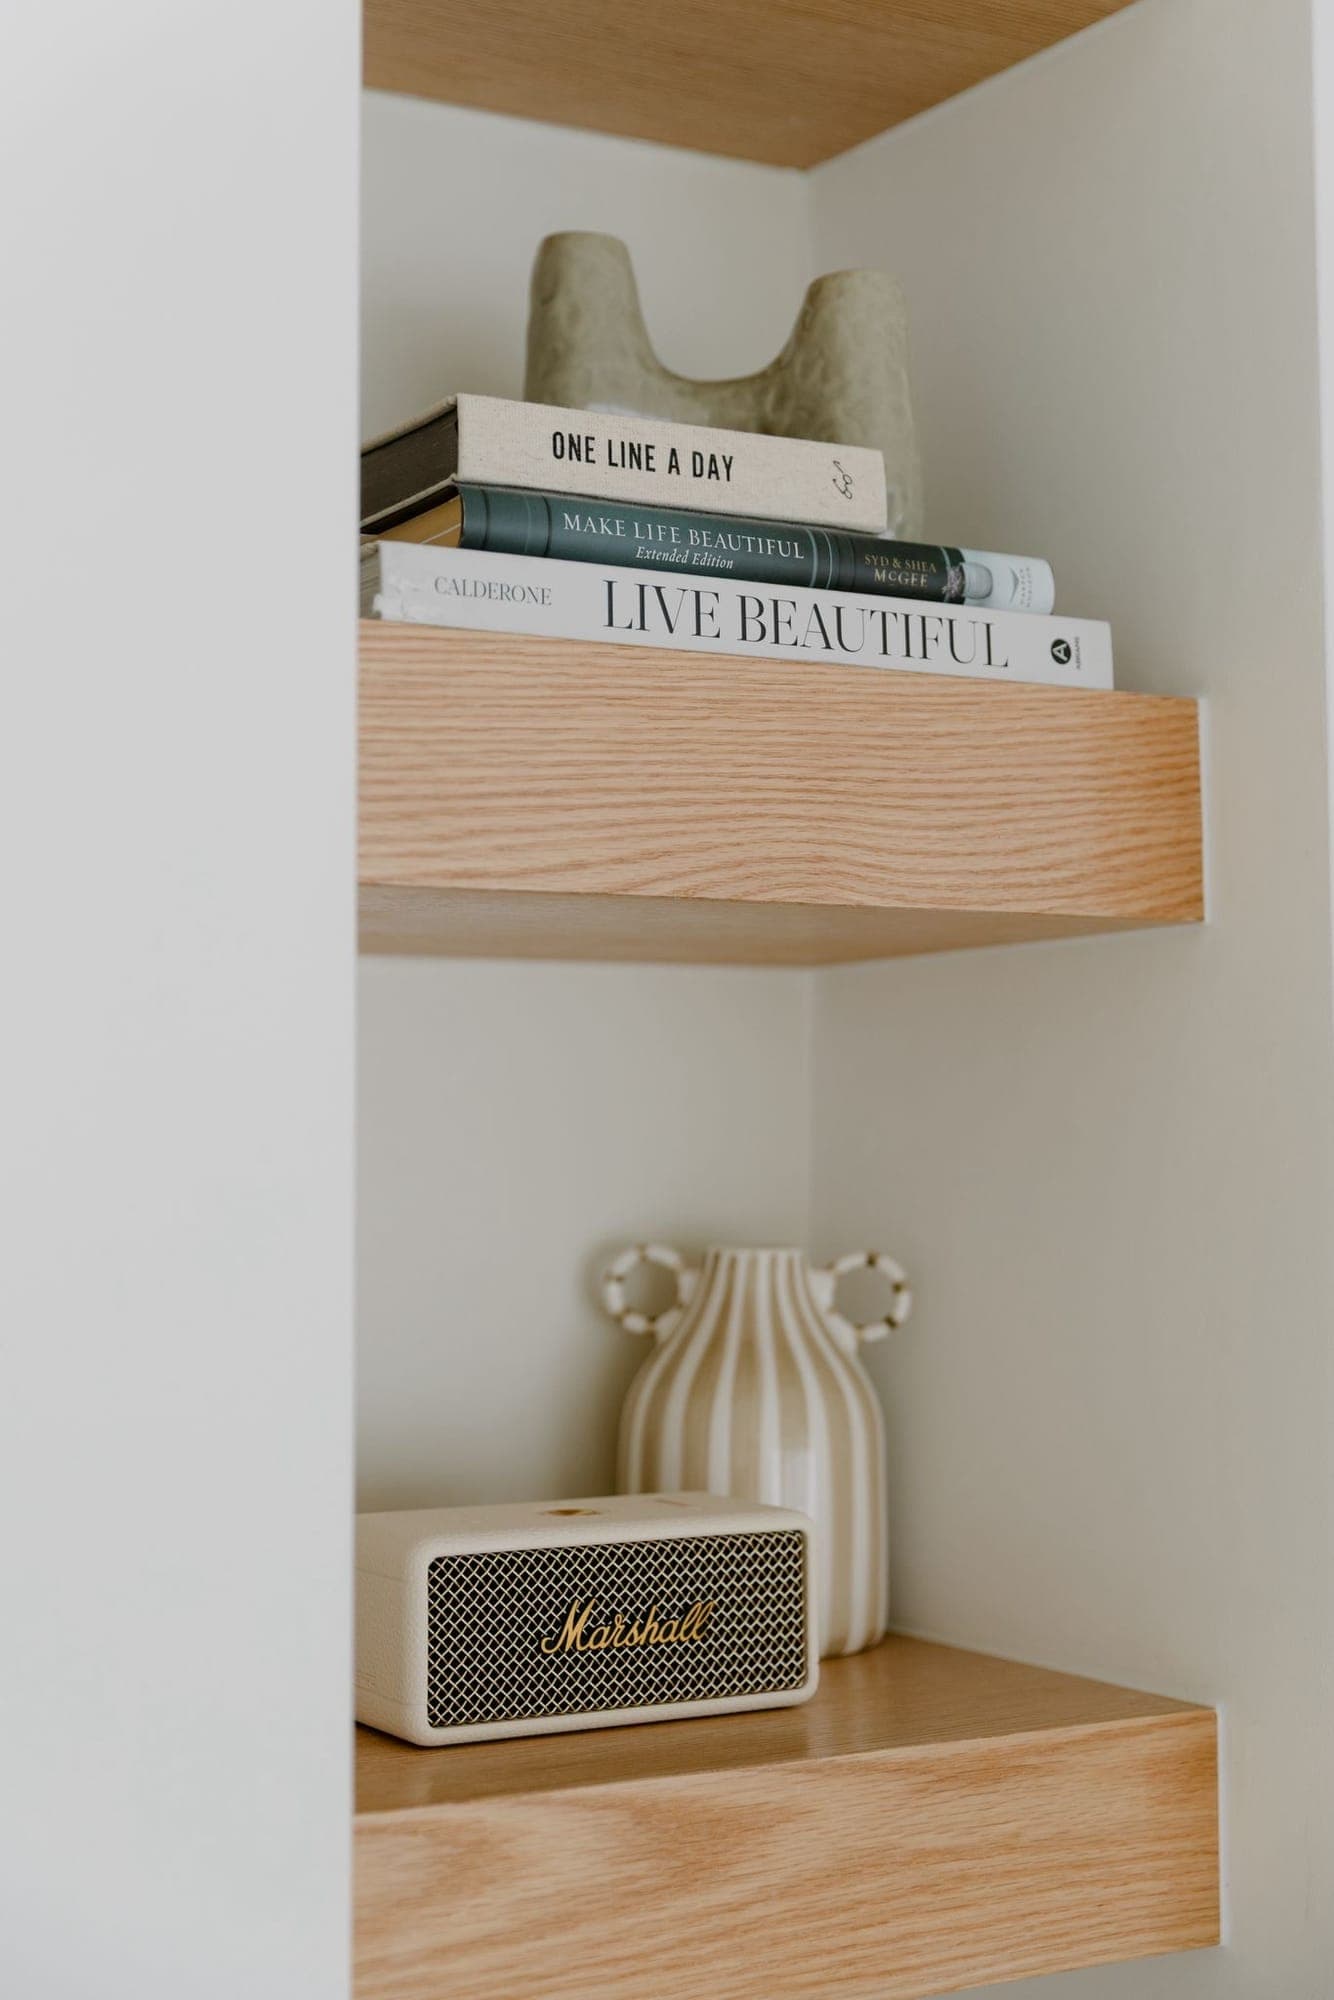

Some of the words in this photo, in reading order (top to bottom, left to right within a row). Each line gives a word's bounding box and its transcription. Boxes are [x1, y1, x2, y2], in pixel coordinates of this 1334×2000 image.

[552, 431, 596, 464] ONE
[607, 439, 656, 473] LINE
[667, 447, 680, 476] A
[692, 451, 734, 482] DAY
[563, 512, 627, 537] MAKE
[633, 522, 681, 544] LIFE
[689, 528, 805, 560] BEAUTIFUL
[635, 546, 688, 565] Extended
[692, 551, 734, 570] Edition
[864, 553, 889, 567] SYD
[892, 557, 901, 569] &
[905, 559, 937, 574] SHEA
[434, 576, 552, 605] CALDERONE
[602, 579, 721, 639] LIVE
[735, 594, 1009, 668] BEAUTIFUL
[541, 1599, 716, 1655] Marshall
